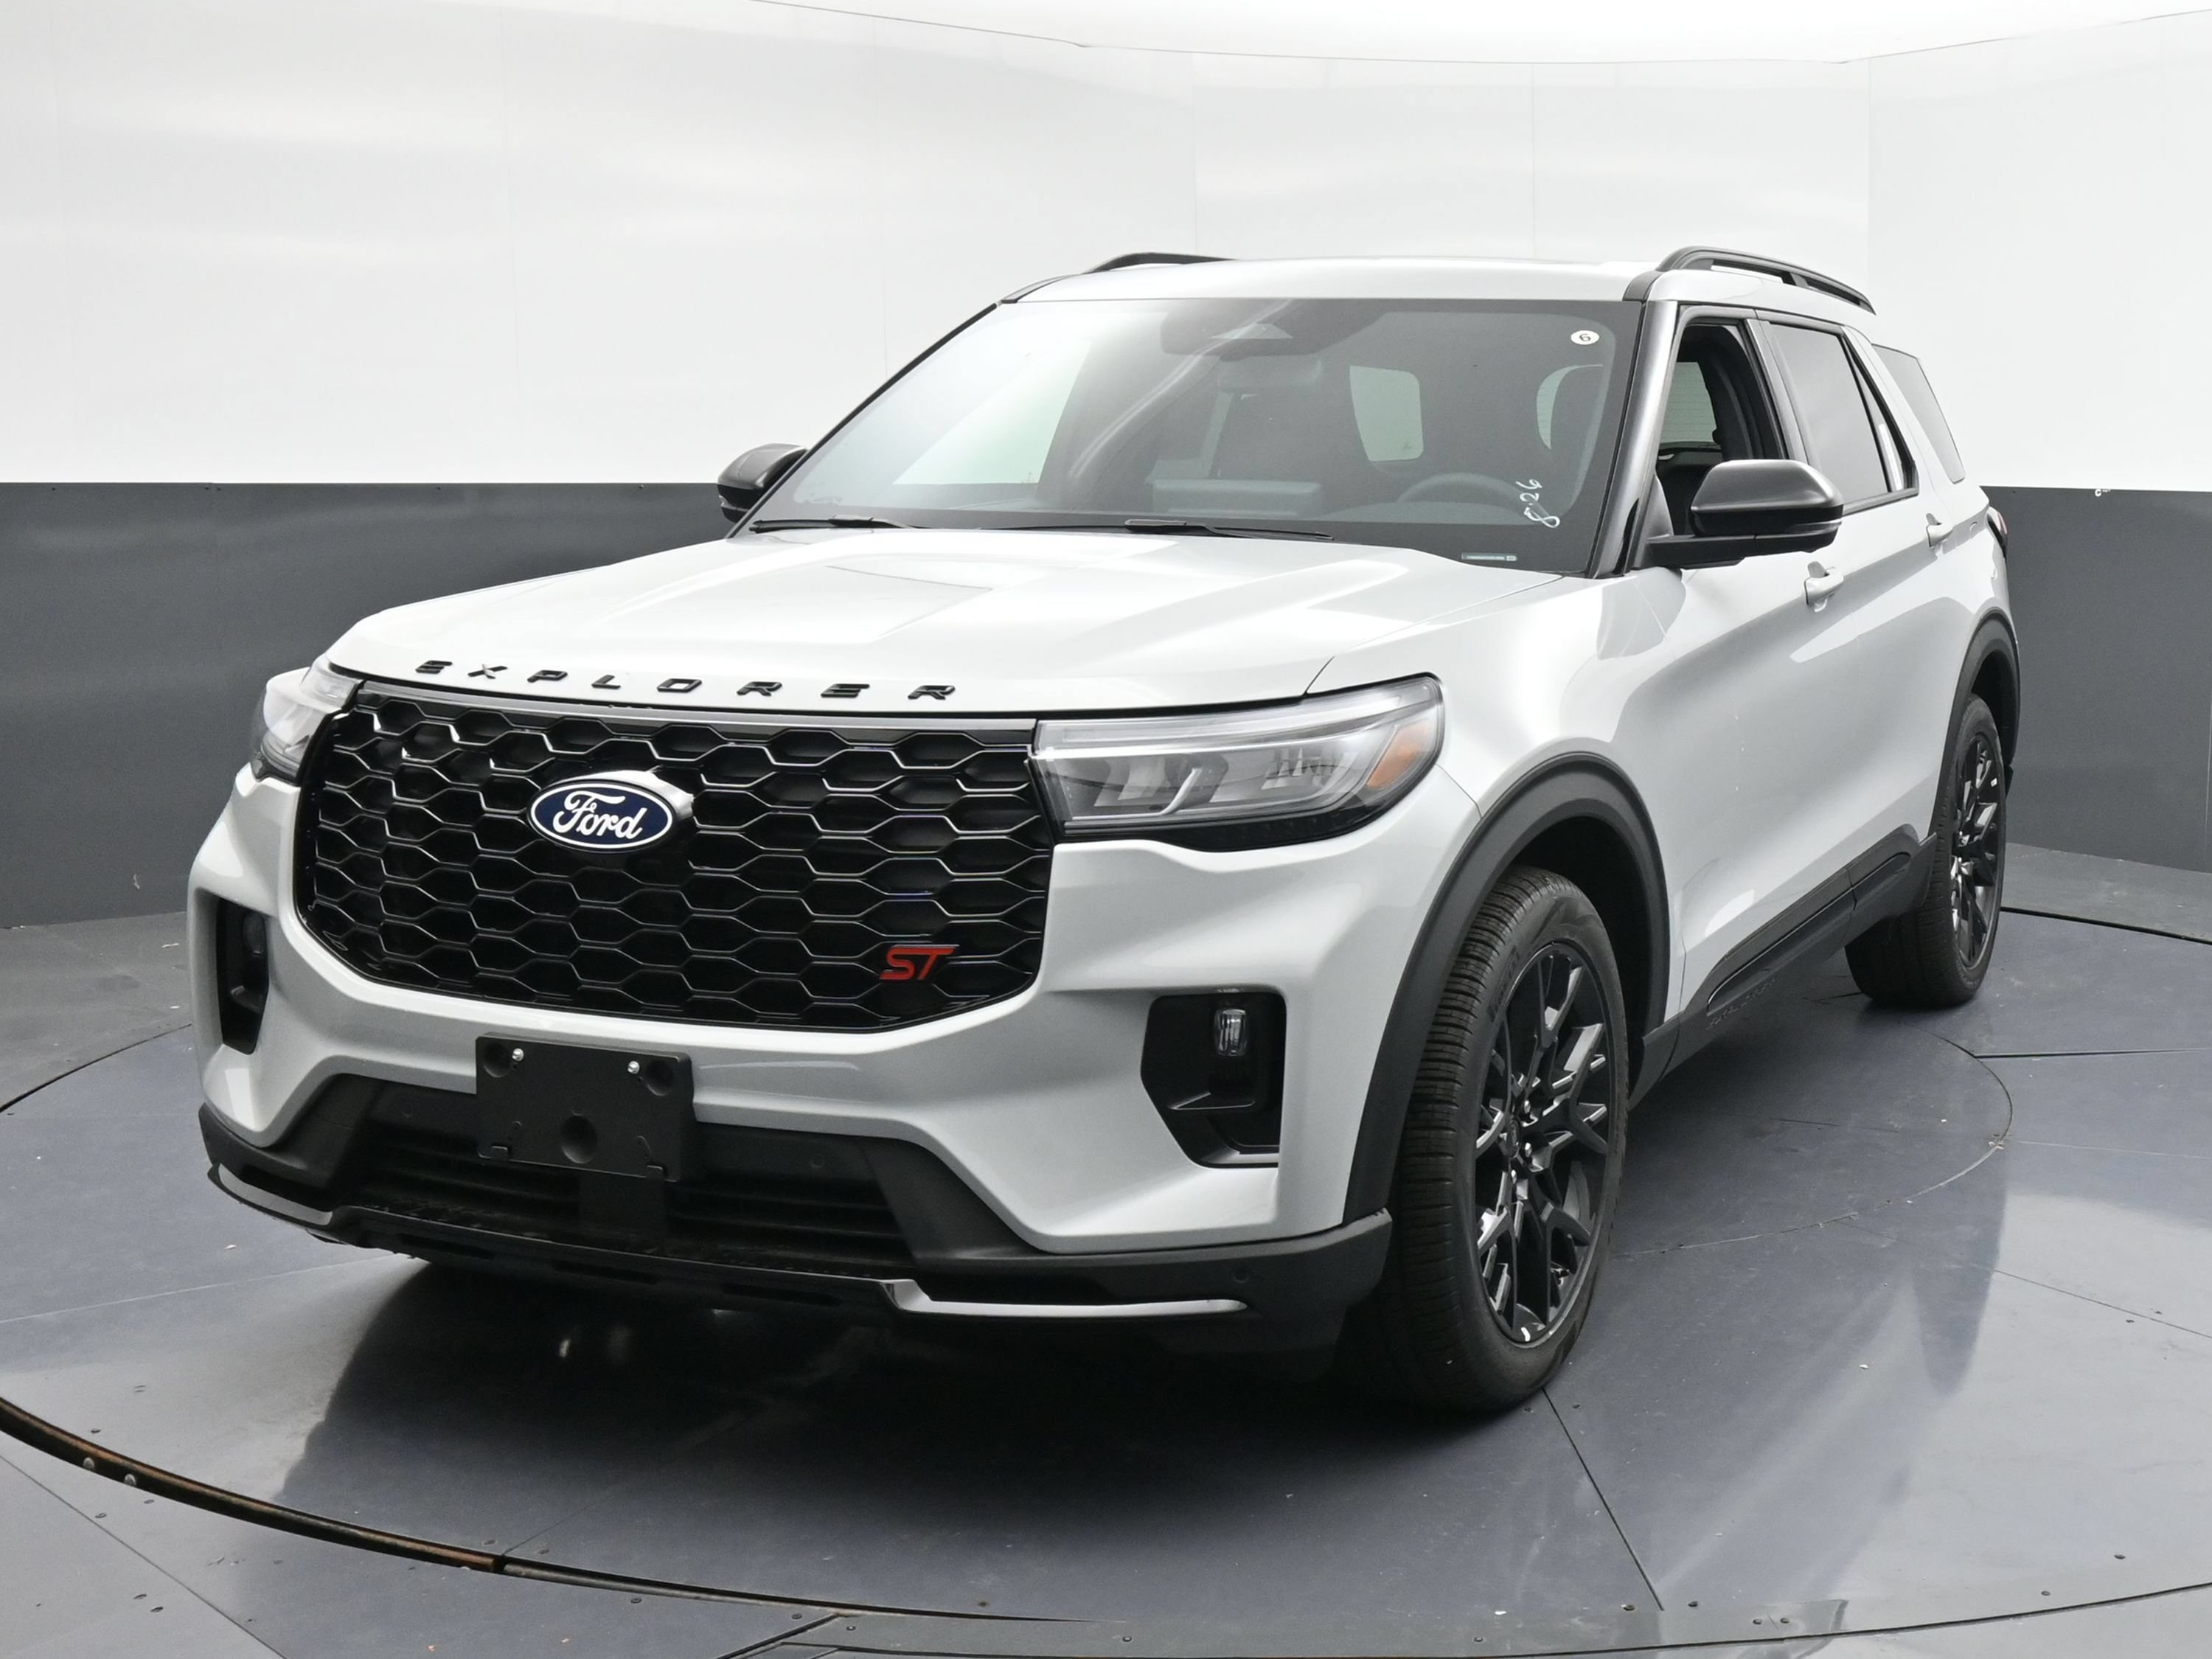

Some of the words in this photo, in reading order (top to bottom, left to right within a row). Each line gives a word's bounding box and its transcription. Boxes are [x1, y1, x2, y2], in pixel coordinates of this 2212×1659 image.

[1579, 333, 1591, 341] 6
[415, 660, 956, 700] EXPLORER
[553, 790, 647, 838] Ford
[880, 946, 956, 980] ST
